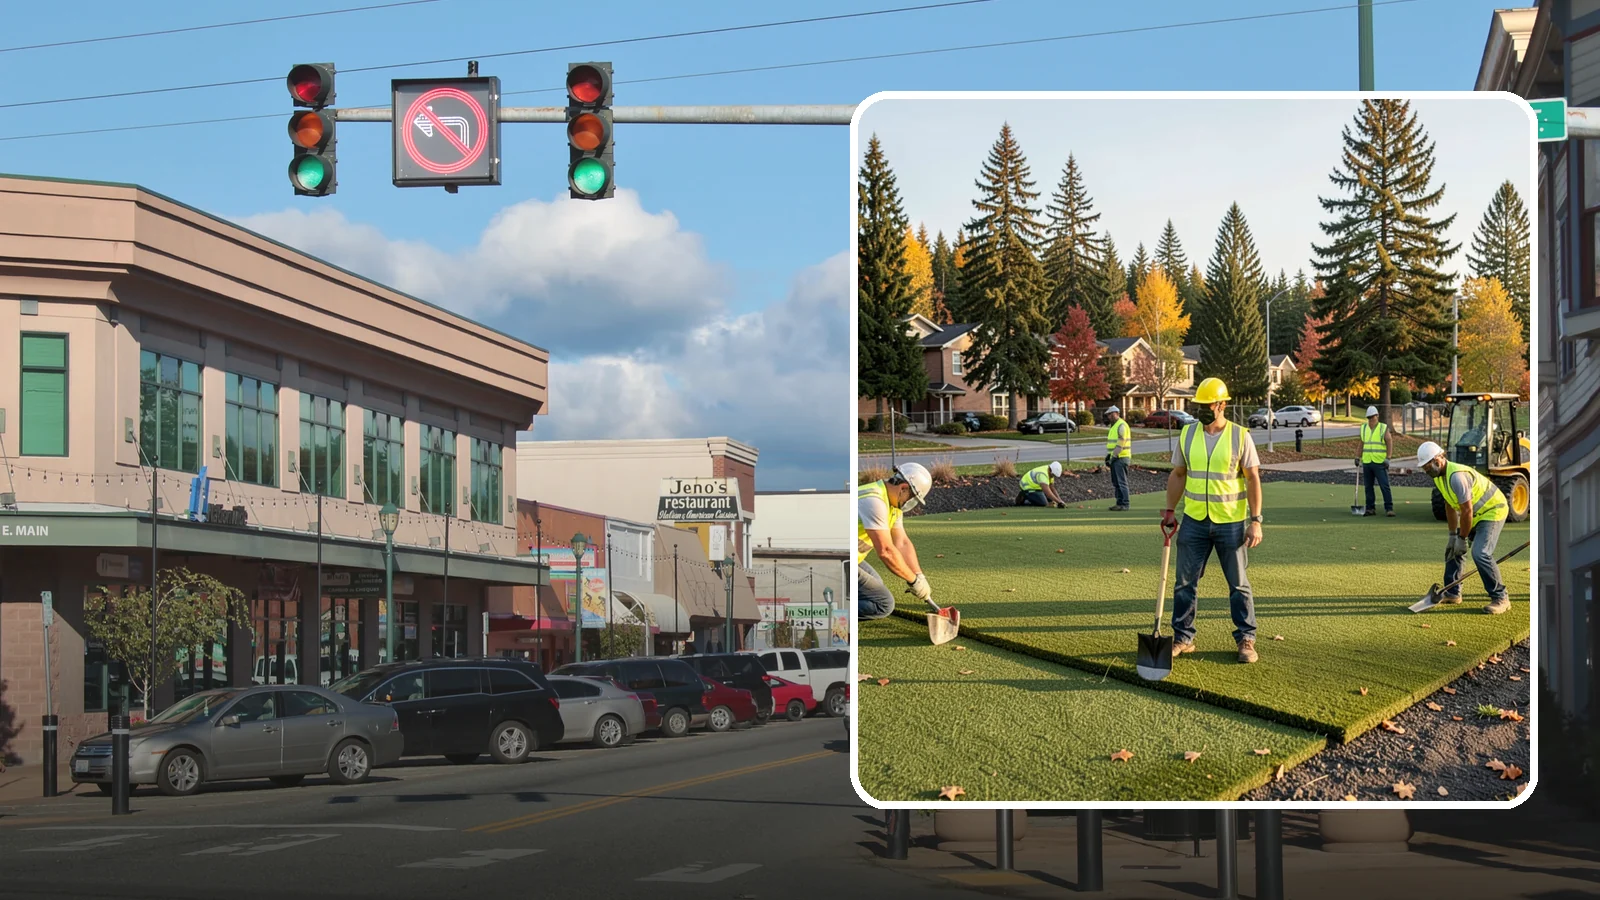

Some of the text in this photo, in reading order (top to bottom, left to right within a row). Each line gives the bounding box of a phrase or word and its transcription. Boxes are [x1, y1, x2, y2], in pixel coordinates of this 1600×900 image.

[670, 480, 727, 494] Jeno's
[665, 496, 731, 509] restaurant
[658, 510, 681, 519] Italian
[686, 510, 715, 519] American
[715, 509, 738, 519] Cuisine
[2, 525, 49, 537] E. MAIN
[797, 607, 829, 617] Street
